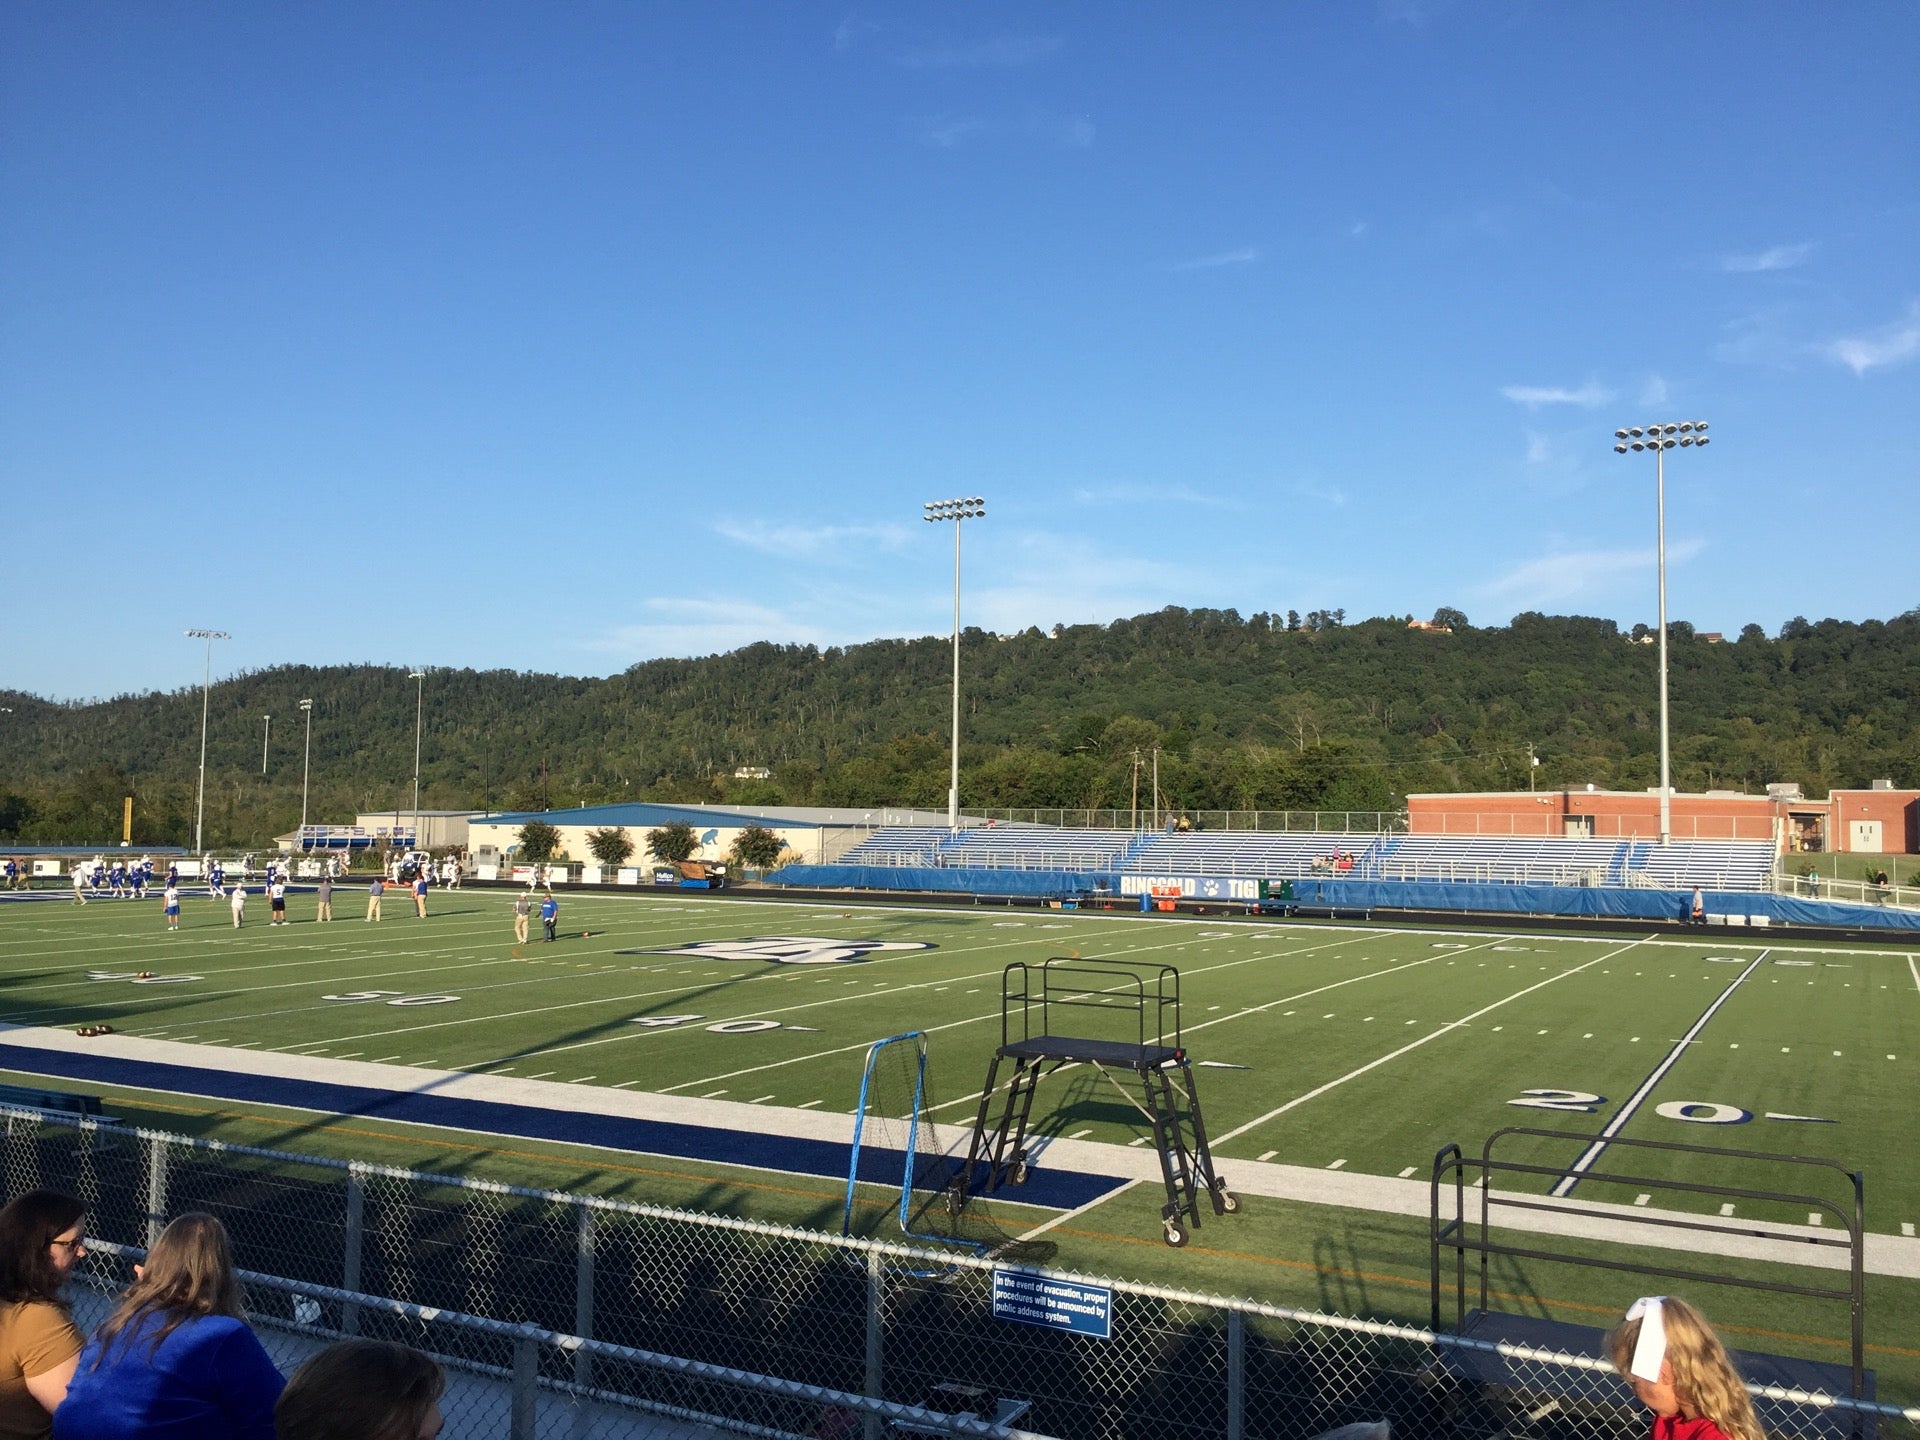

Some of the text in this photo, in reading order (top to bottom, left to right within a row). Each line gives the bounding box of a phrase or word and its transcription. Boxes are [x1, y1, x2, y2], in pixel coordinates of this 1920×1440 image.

[997, 1276, 1107, 1304] In the event of evacuation, proper
[996, 1291, 1105, 1319] procedures will be announced by
[996, 1303, 1072, 1324] public address system.
